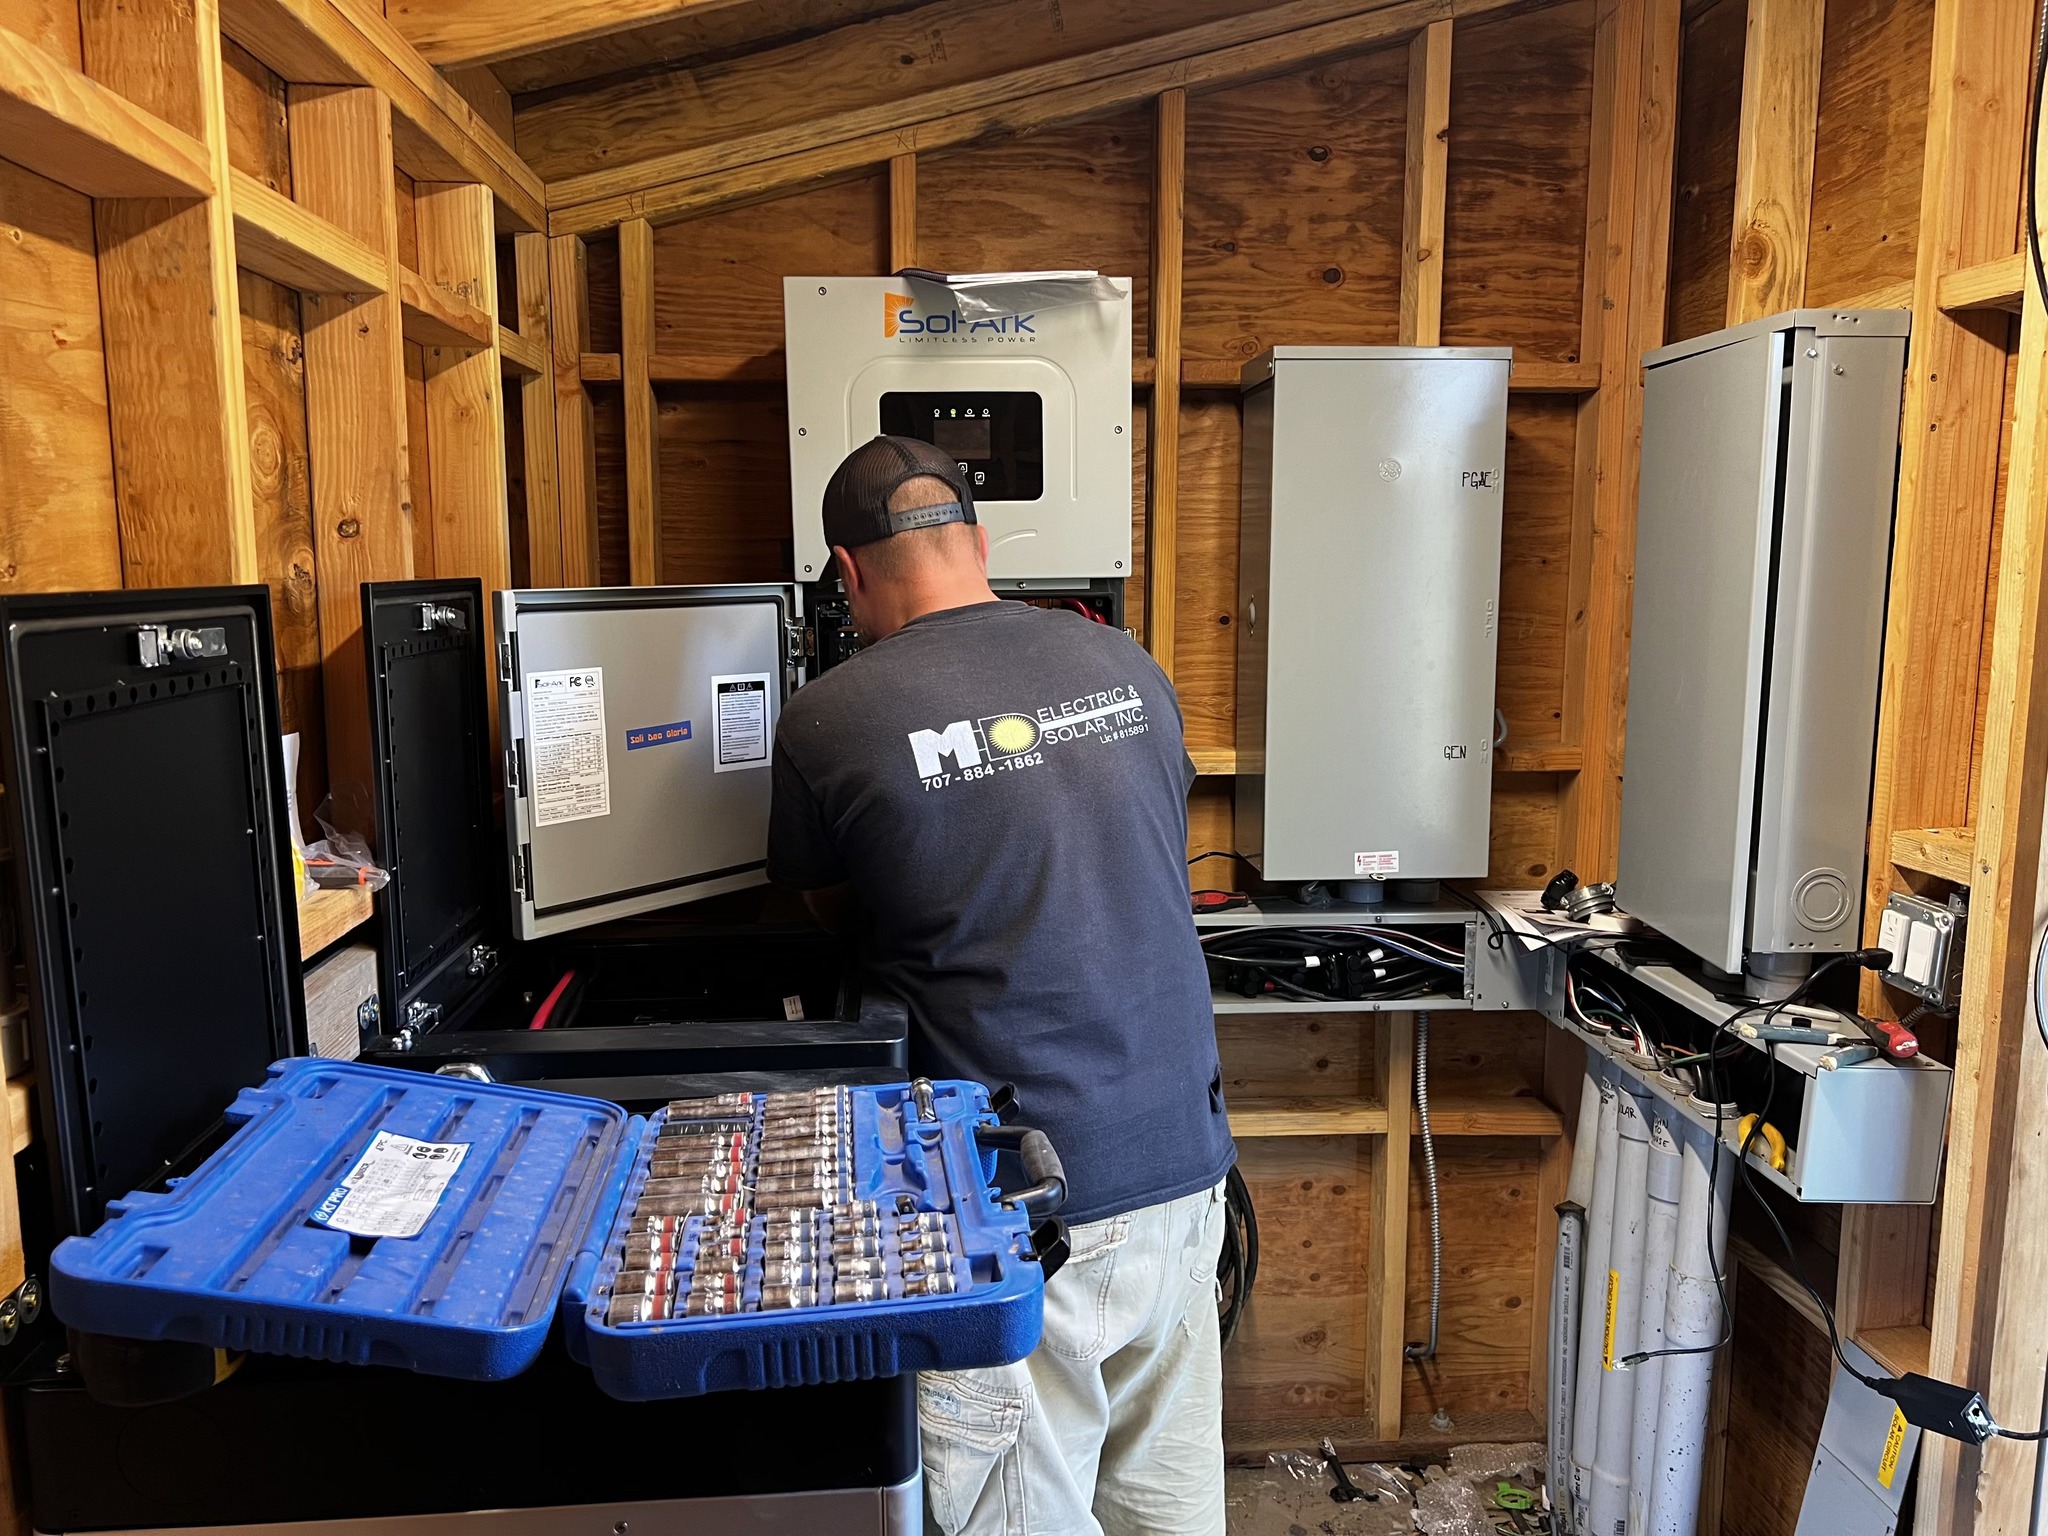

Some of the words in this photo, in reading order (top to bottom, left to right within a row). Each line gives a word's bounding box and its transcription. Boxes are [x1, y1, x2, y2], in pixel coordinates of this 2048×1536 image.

[1036, 686, 1125, 723] ELECTRIC
[1127, 684, 1140, 699] &
[1044, 717, 1113, 746] SOLAR,
[1115, 708, 1149, 728] INC.
[1443, 745, 1467, 761] GEN
[1889, 1414, 1900, 1440] SOLAR
[1881, 1441, 1893, 1471] CIRCUIT
[1889, 1434, 1901, 1468] CAUTION
